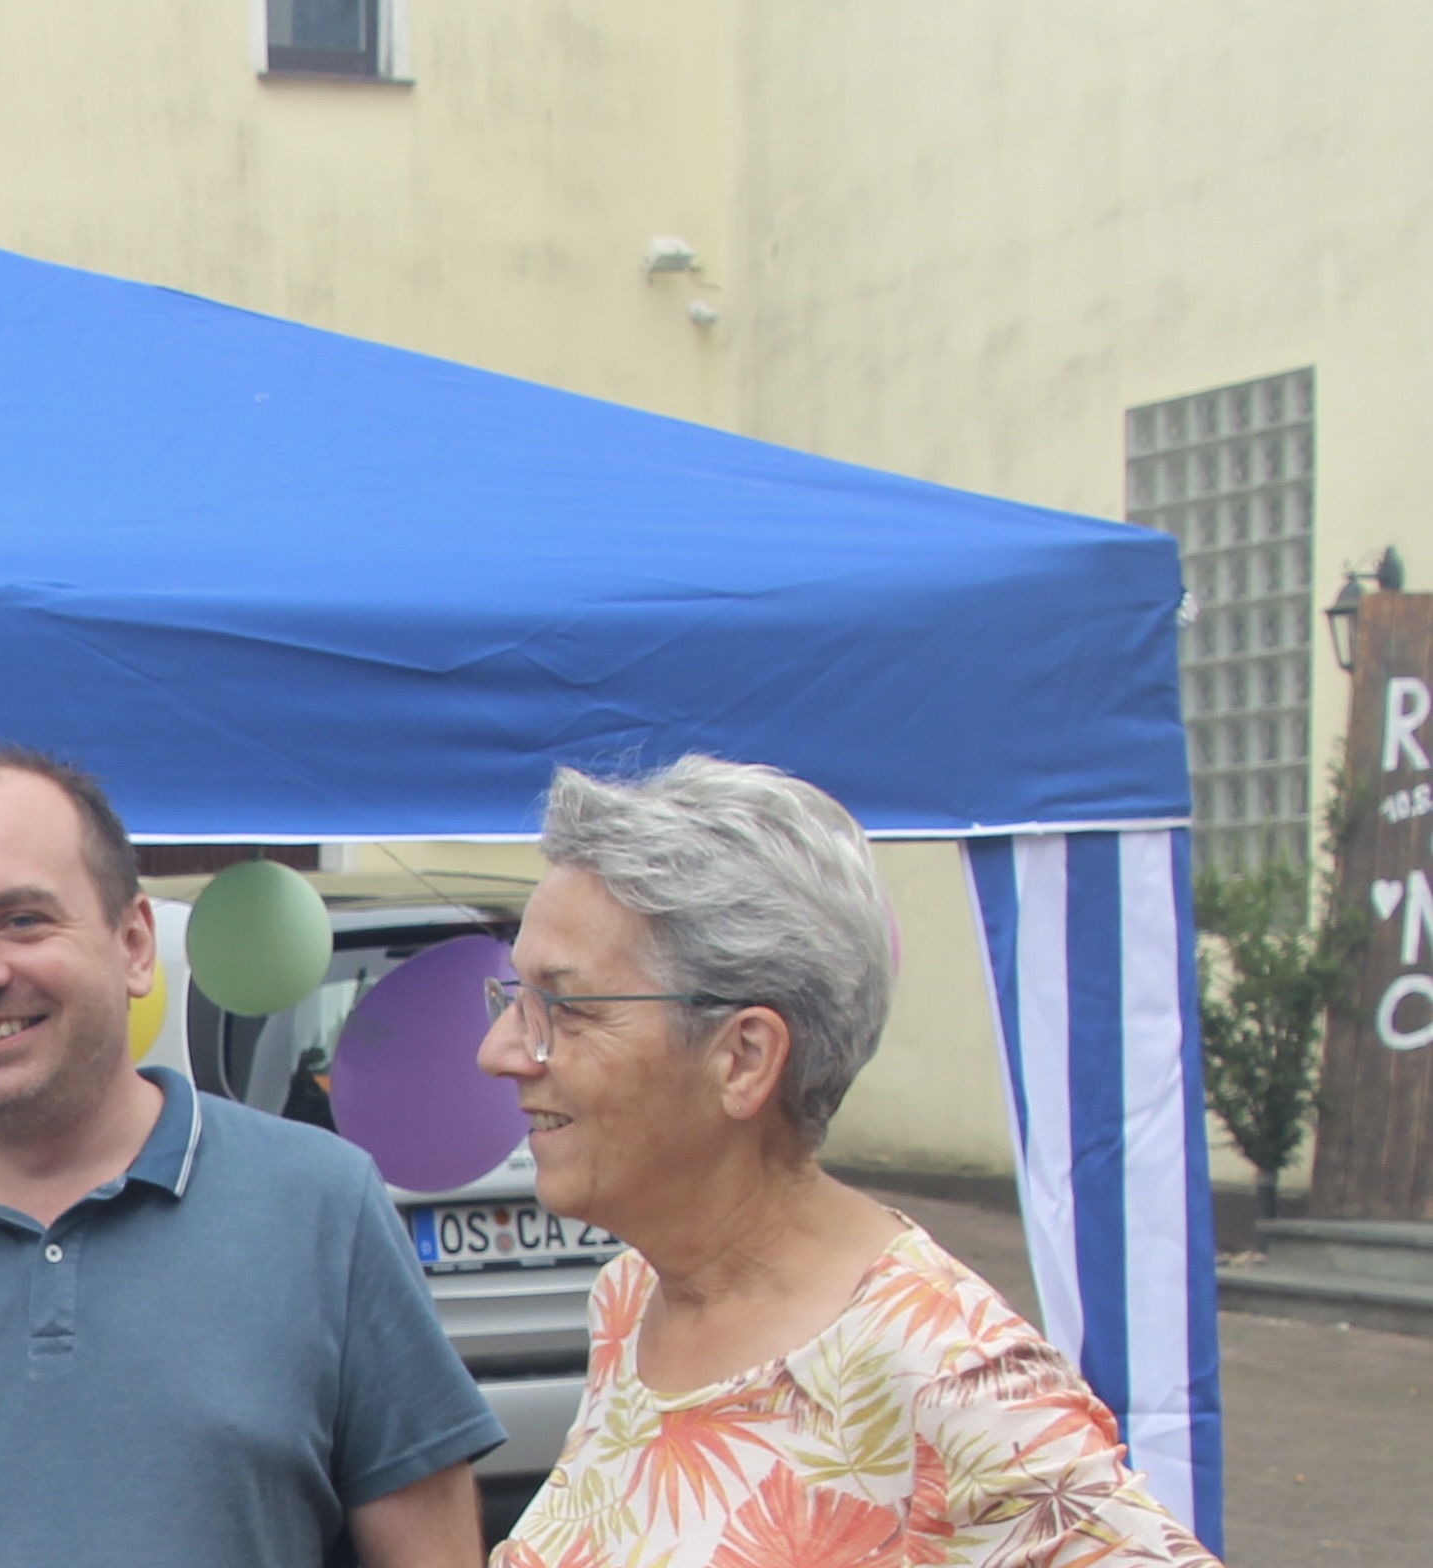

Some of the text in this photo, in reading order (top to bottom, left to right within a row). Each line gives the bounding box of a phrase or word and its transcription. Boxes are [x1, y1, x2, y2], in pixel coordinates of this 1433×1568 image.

[1381, 676, 1432, 772] R
[440, 1210, 490, 1254] OS
[516, 1208, 566, 1249] CA
